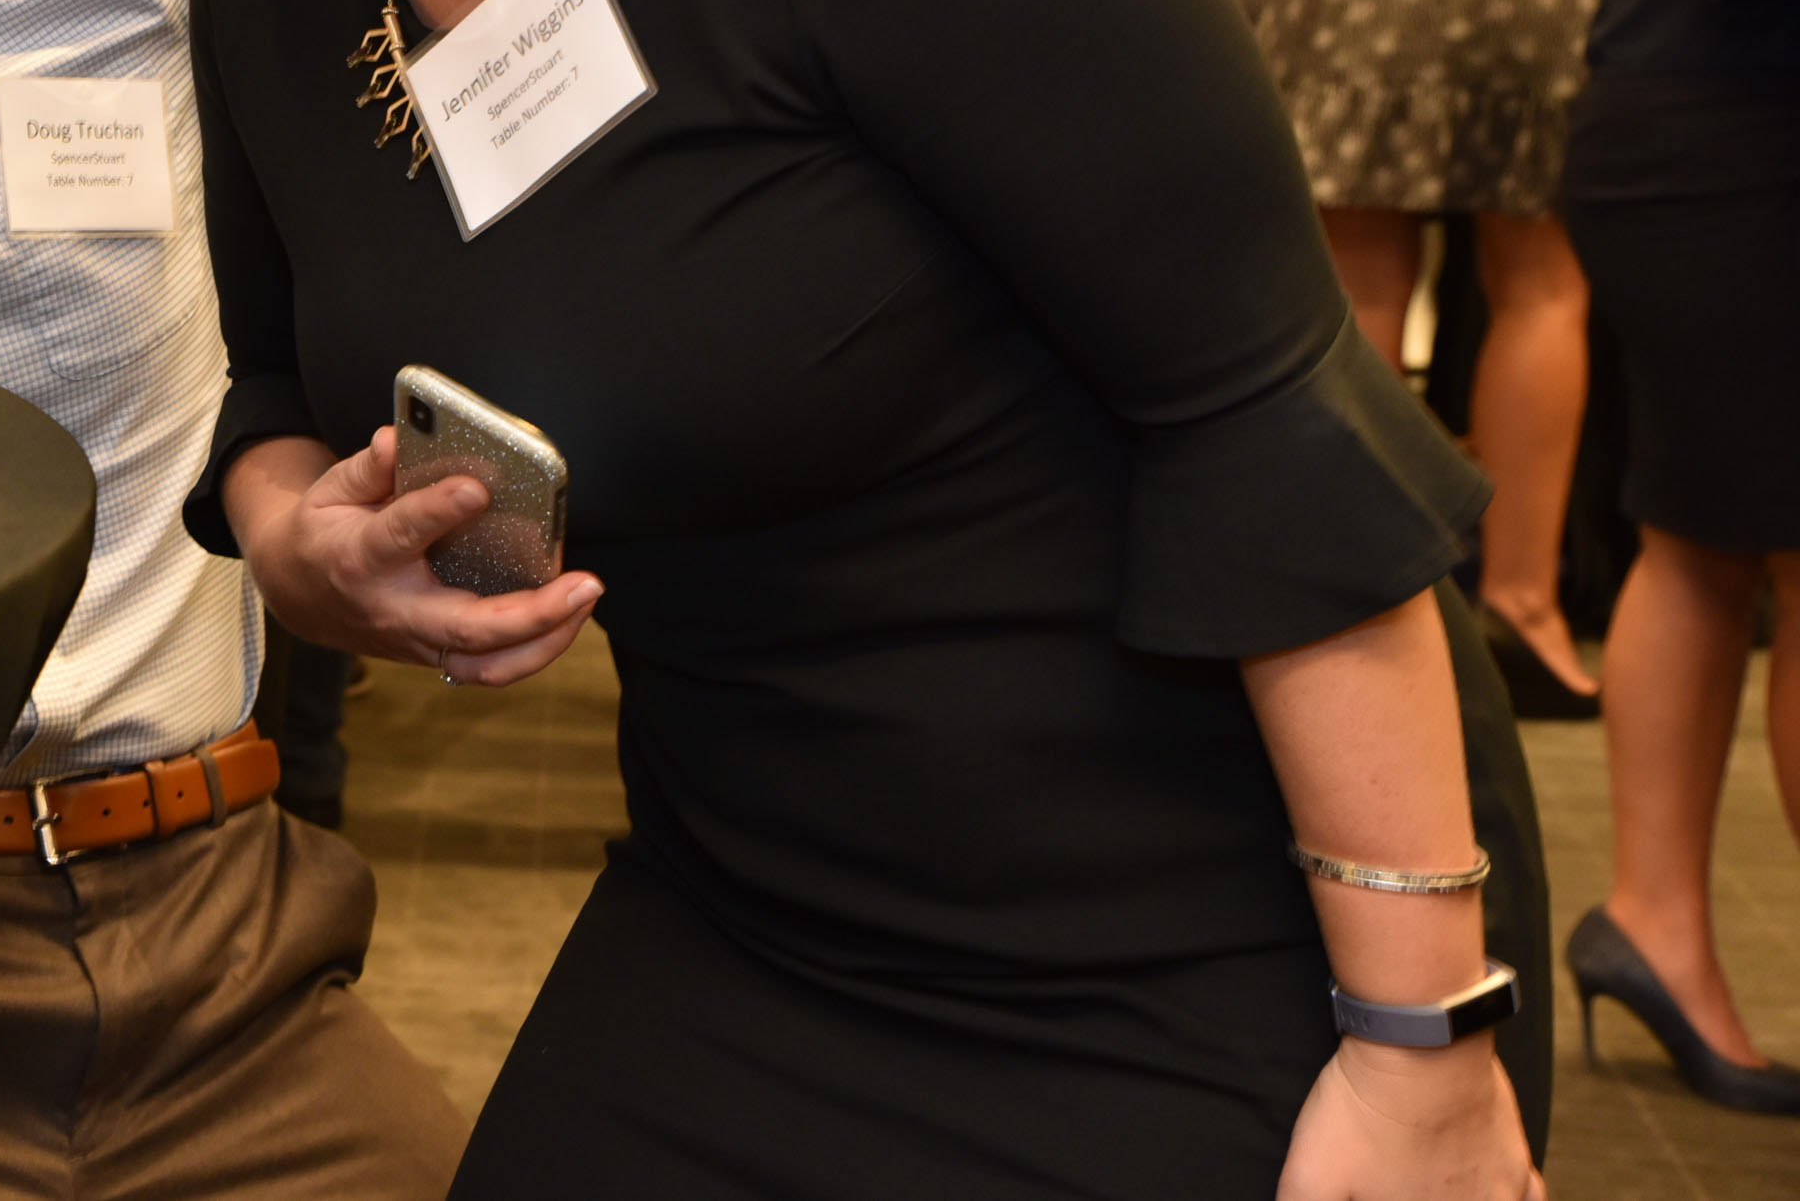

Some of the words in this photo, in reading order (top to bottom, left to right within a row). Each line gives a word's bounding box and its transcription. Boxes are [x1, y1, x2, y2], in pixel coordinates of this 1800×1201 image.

[440, 50, 513, 123] Jennifer
[486, 49, 565, 122] SpencerStuart
[490, 118, 522, 151] Table
[520, 78, 572, 124] Number:
[570, 65, 581, 82] 7
[26, 120, 72, 144] Doug
[75, 119, 144, 140] Truchan
[47, 174, 75, 188] Table
[126, 174, 134, 187] 7
[50, 151, 126, 167] SpencerStuart
